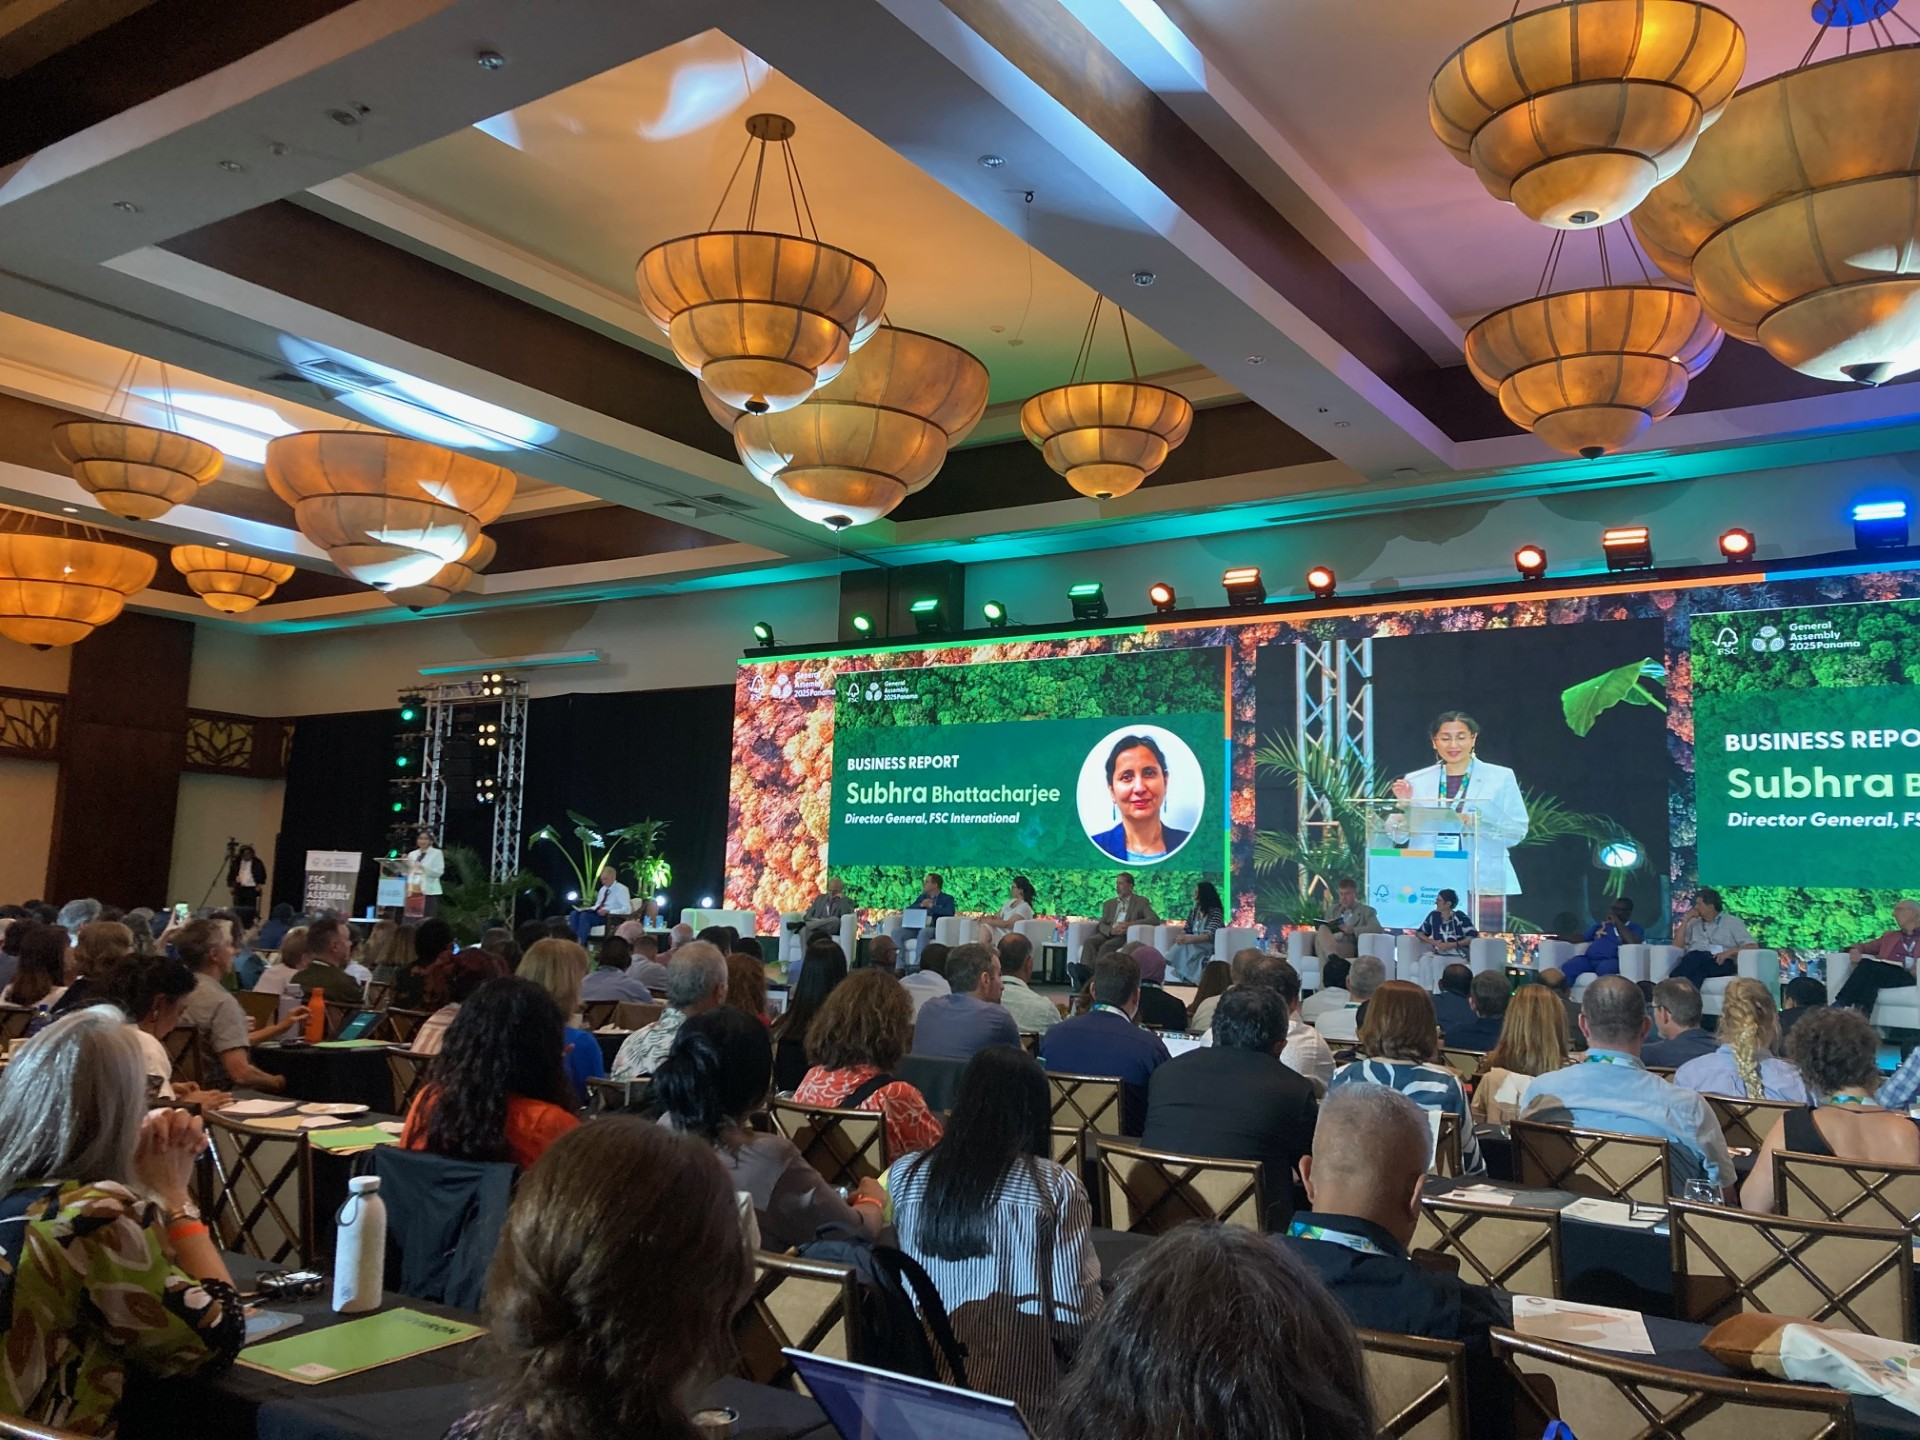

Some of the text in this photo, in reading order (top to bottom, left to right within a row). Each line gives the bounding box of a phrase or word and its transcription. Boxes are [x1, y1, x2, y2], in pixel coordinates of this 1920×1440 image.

[1789, 621, 1832, 632] General
[1789, 630, 1841, 641] Assembly
[1717, 647, 1739, 655] FSC
[1789, 640, 1861, 651] 2025 Panama
[810, 689, 836, 697] Panama
[1725, 728, 1920, 752] BUSINESS REPO
[847, 754, 960, 771] BUSINESS REPORT
[1727, 766, 1894, 799] Subhra
[846, 781, 1061, 806] Subhra Bhattacharjee
[844, 812, 1020, 825] Director General, FSC International
[1727, 812, 1807, 827] Director
[1810, 811, 1899, 829] General,
[308, 875, 326, 883] FSC
[307, 883, 347, 891] GENERAL
[306, 891, 351, 900] ASSEMBLY
